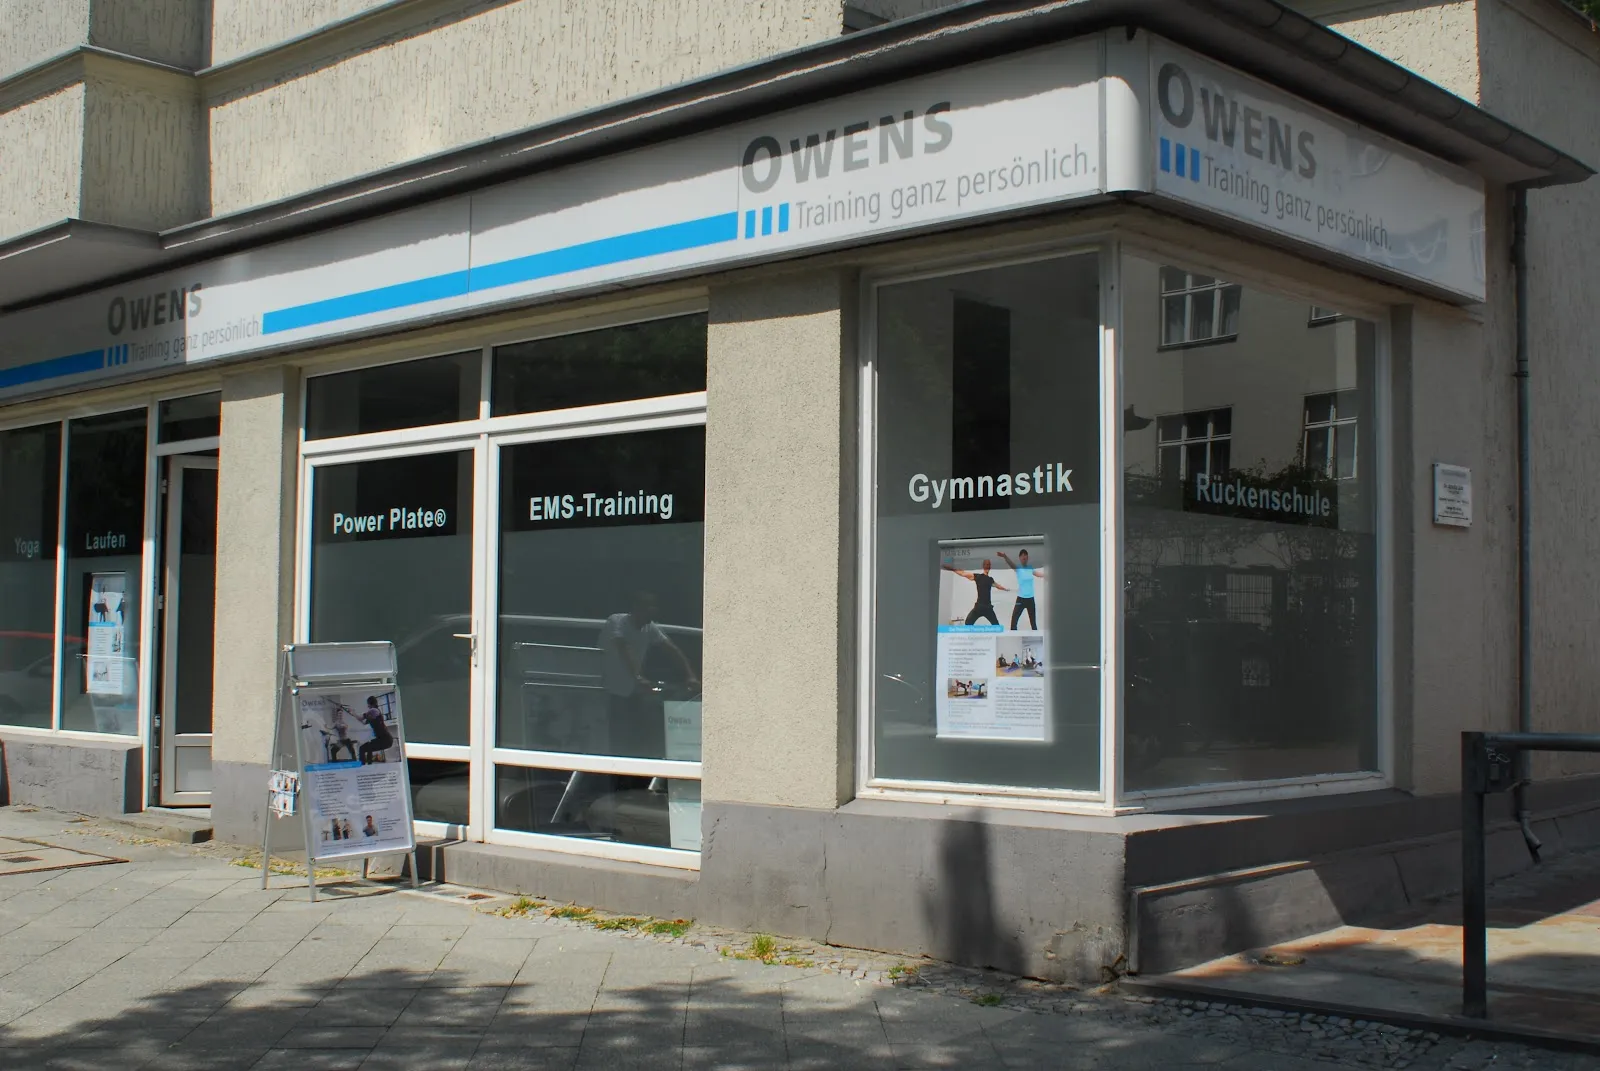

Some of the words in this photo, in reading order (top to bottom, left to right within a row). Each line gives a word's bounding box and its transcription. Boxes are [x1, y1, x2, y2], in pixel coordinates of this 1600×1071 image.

[1158, 62, 1317, 180] OWENS
[741, 101, 953, 194] OWENS
[796, 190, 881, 229] Training
[891, 178, 946, 213] ganz
[957, 143, 1097, 206] persönlich.
[1205, 155, 1270, 214] Training
[1276, 188, 1312, 222] ganz
[1317, 203, 1392, 250] persönlich.
[107, 282, 203, 336] OWENS
[130, 340, 170, 363] Training
[173, 334, 199, 358] ganz
[529, 490, 674, 521] EMS-Training
[908, 463, 1073, 508] Gymnastik
[1196, 472, 1330, 517] Rückenschule
[86, 531, 126, 550] Laufen
[334, 512, 385, 535] Power
[390, 507, 446, 531] Plate®
[15, 537, 40, 558] Yoga
